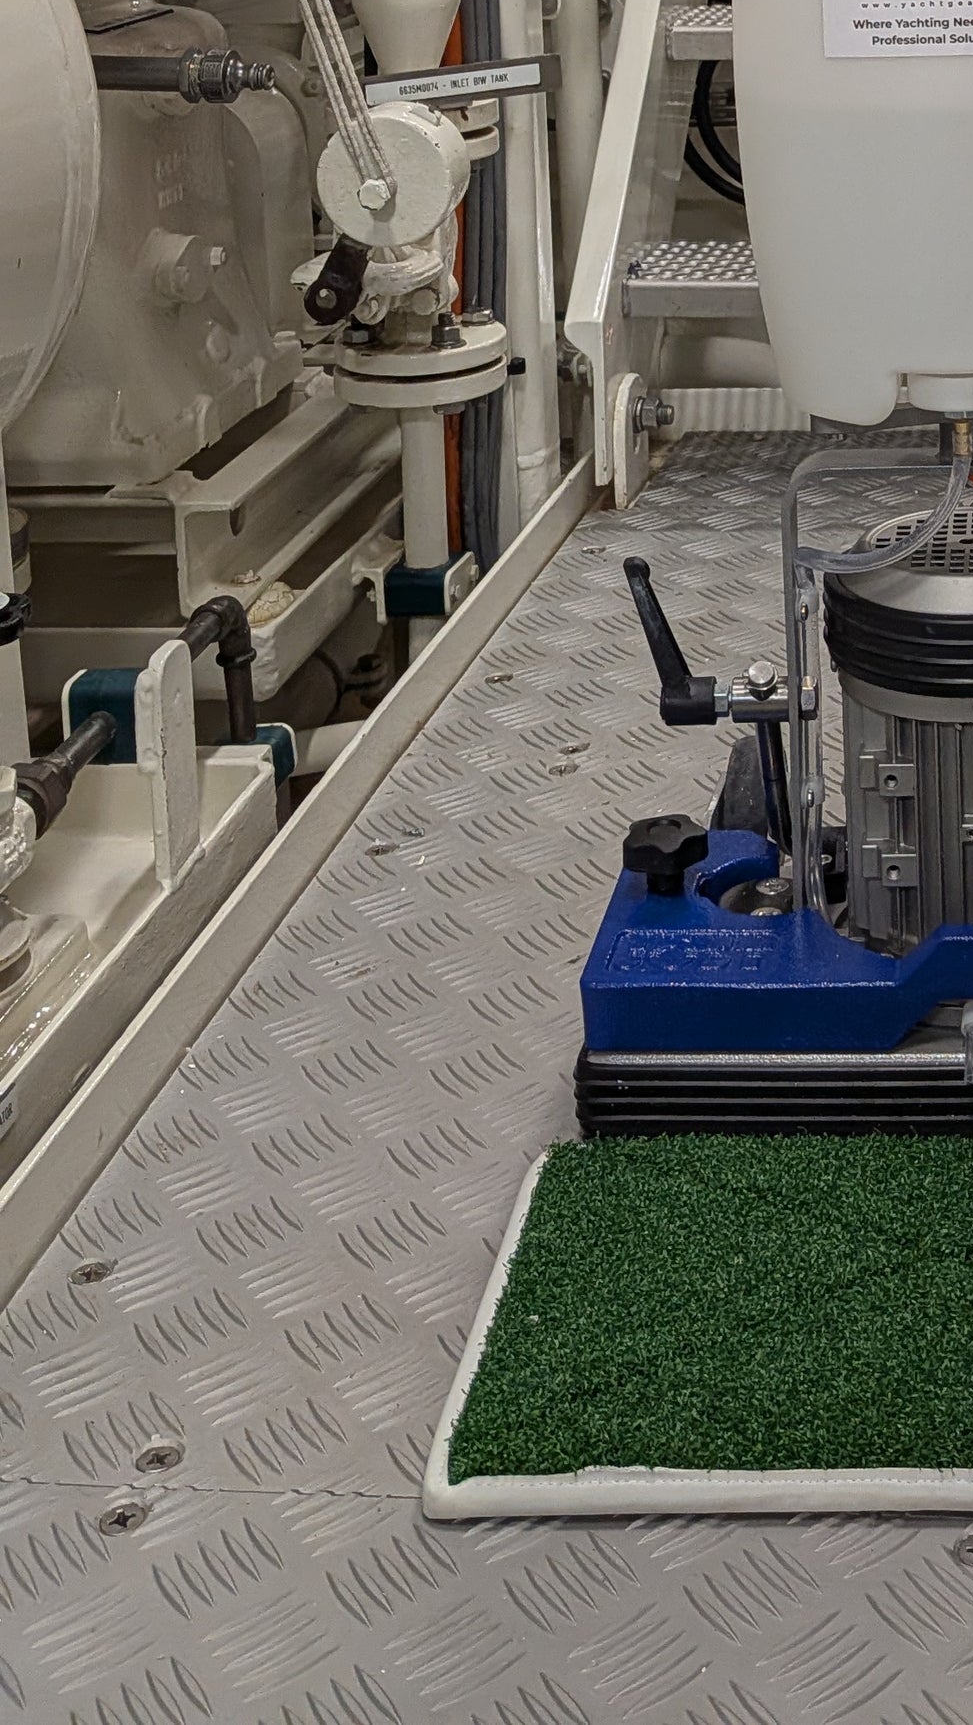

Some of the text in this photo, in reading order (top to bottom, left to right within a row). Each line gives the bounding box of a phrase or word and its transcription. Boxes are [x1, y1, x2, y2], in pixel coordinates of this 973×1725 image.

[853, 19, 892, 30] Where
[895, 17, 950, 30] Yachting
[872, 33, 946, 46] Professional
[399, 81, 439, 96] 6635M0074
[450, 77, 469, 89] INLET
[491, 72, 509, 84] TANK
